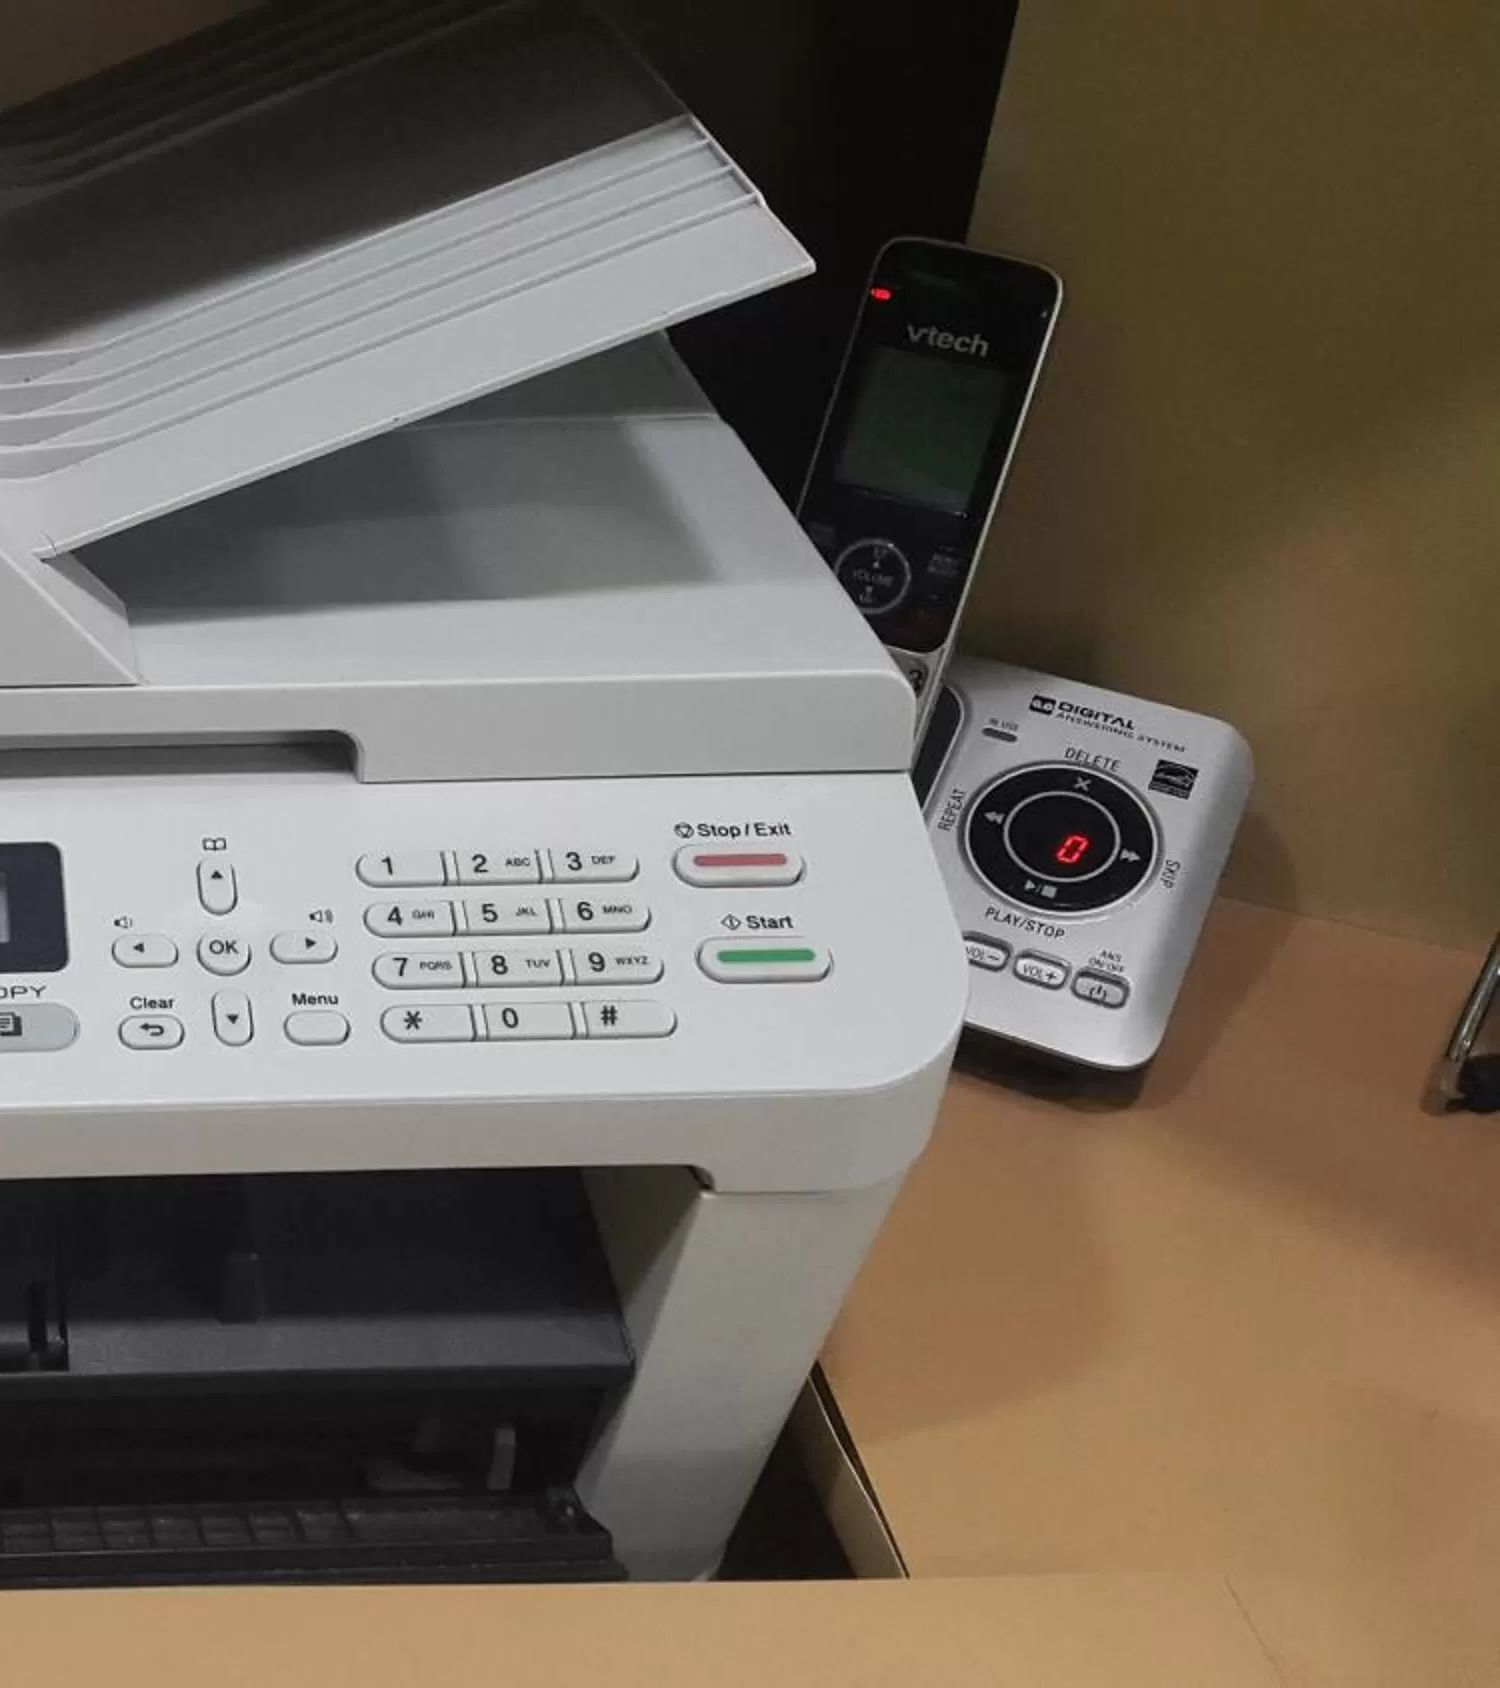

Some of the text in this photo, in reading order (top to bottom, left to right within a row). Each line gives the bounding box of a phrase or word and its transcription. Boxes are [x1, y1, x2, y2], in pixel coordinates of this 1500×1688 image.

[906, 323, 990, 358] vtech
[1057, 700, 1136, 731] DIGITAL
[1137, 734, 1186, 753] SYSTEM
[1063, 746, 1123, 772] DELETE
[936, 788, 966, 832] REPEAT
[697, 823, 741, 839] Stop
[754, 822, 792, 837] Exit
[1054, 833, 1091, 865] 0
[381, 855, 394, 876] 1
[471, 853, 532, 873] 2 ABC
[565, 851, 617, 871] 3 DEF
[1162, 858, 1182, 890] SKIP
[387, 905, 404, 926] 4
[481, 903, 499, 923] 5
[576, 901, 594, 921] 6
[745, 915, 794, 930] Start
[985, 906, 1066, 940] PLAY/STOP
[208, 939, 238, 955] OK
[392, 956, 409, 977] 7
[491, 954, 551, 975] 8 TUV
[587, 951, 650, 973] 9 WXYZ
[129, 996, 176, 1010] Clear
[291, 992, 339, 1006] Menu
[501, 1006, 519, 1029] 0
[599, 1005, 619, 1026] #
